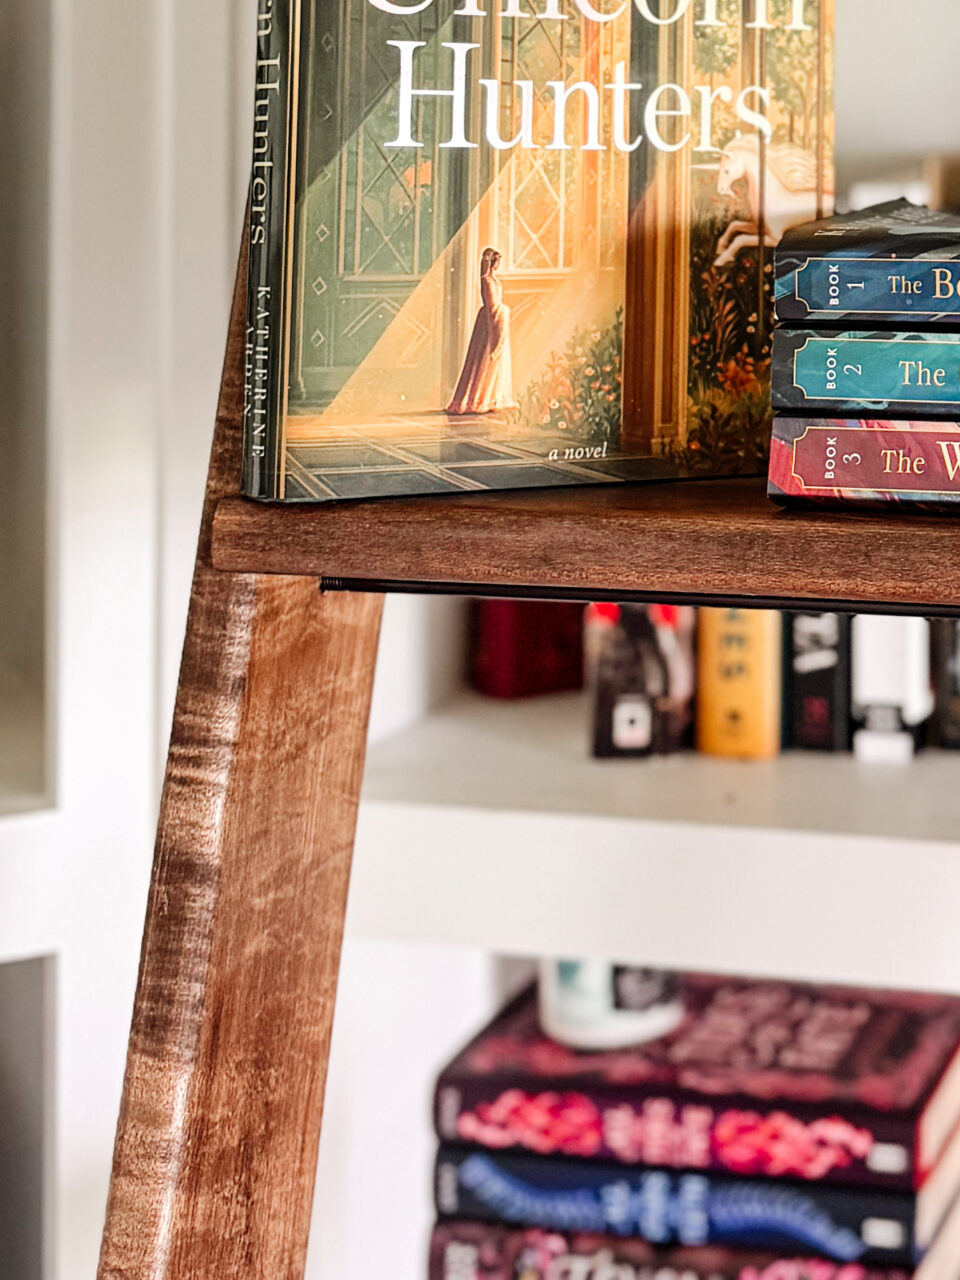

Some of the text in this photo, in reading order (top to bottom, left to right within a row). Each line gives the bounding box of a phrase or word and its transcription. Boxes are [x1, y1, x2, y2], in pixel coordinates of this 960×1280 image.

[383, 38, 774, 152] Hunters
[250, 53, 281, 246] Hunters
[828, 264, 840, 306] BOOK
[846, 281, 865, 291] 1
[888, 275, 923, 294] The
[252, 285, 272, 457] KATHERINE
[826, 348, 838, 390] BOOK
[843, 364, 862, 376] 2
[898, 361, 946, 387] The
[548, 440, 608, 461] a novel
[824, 437, 838, 479] BOOK
[842, 453, 862, 465] 3
[880, 449, 926, 474] The
